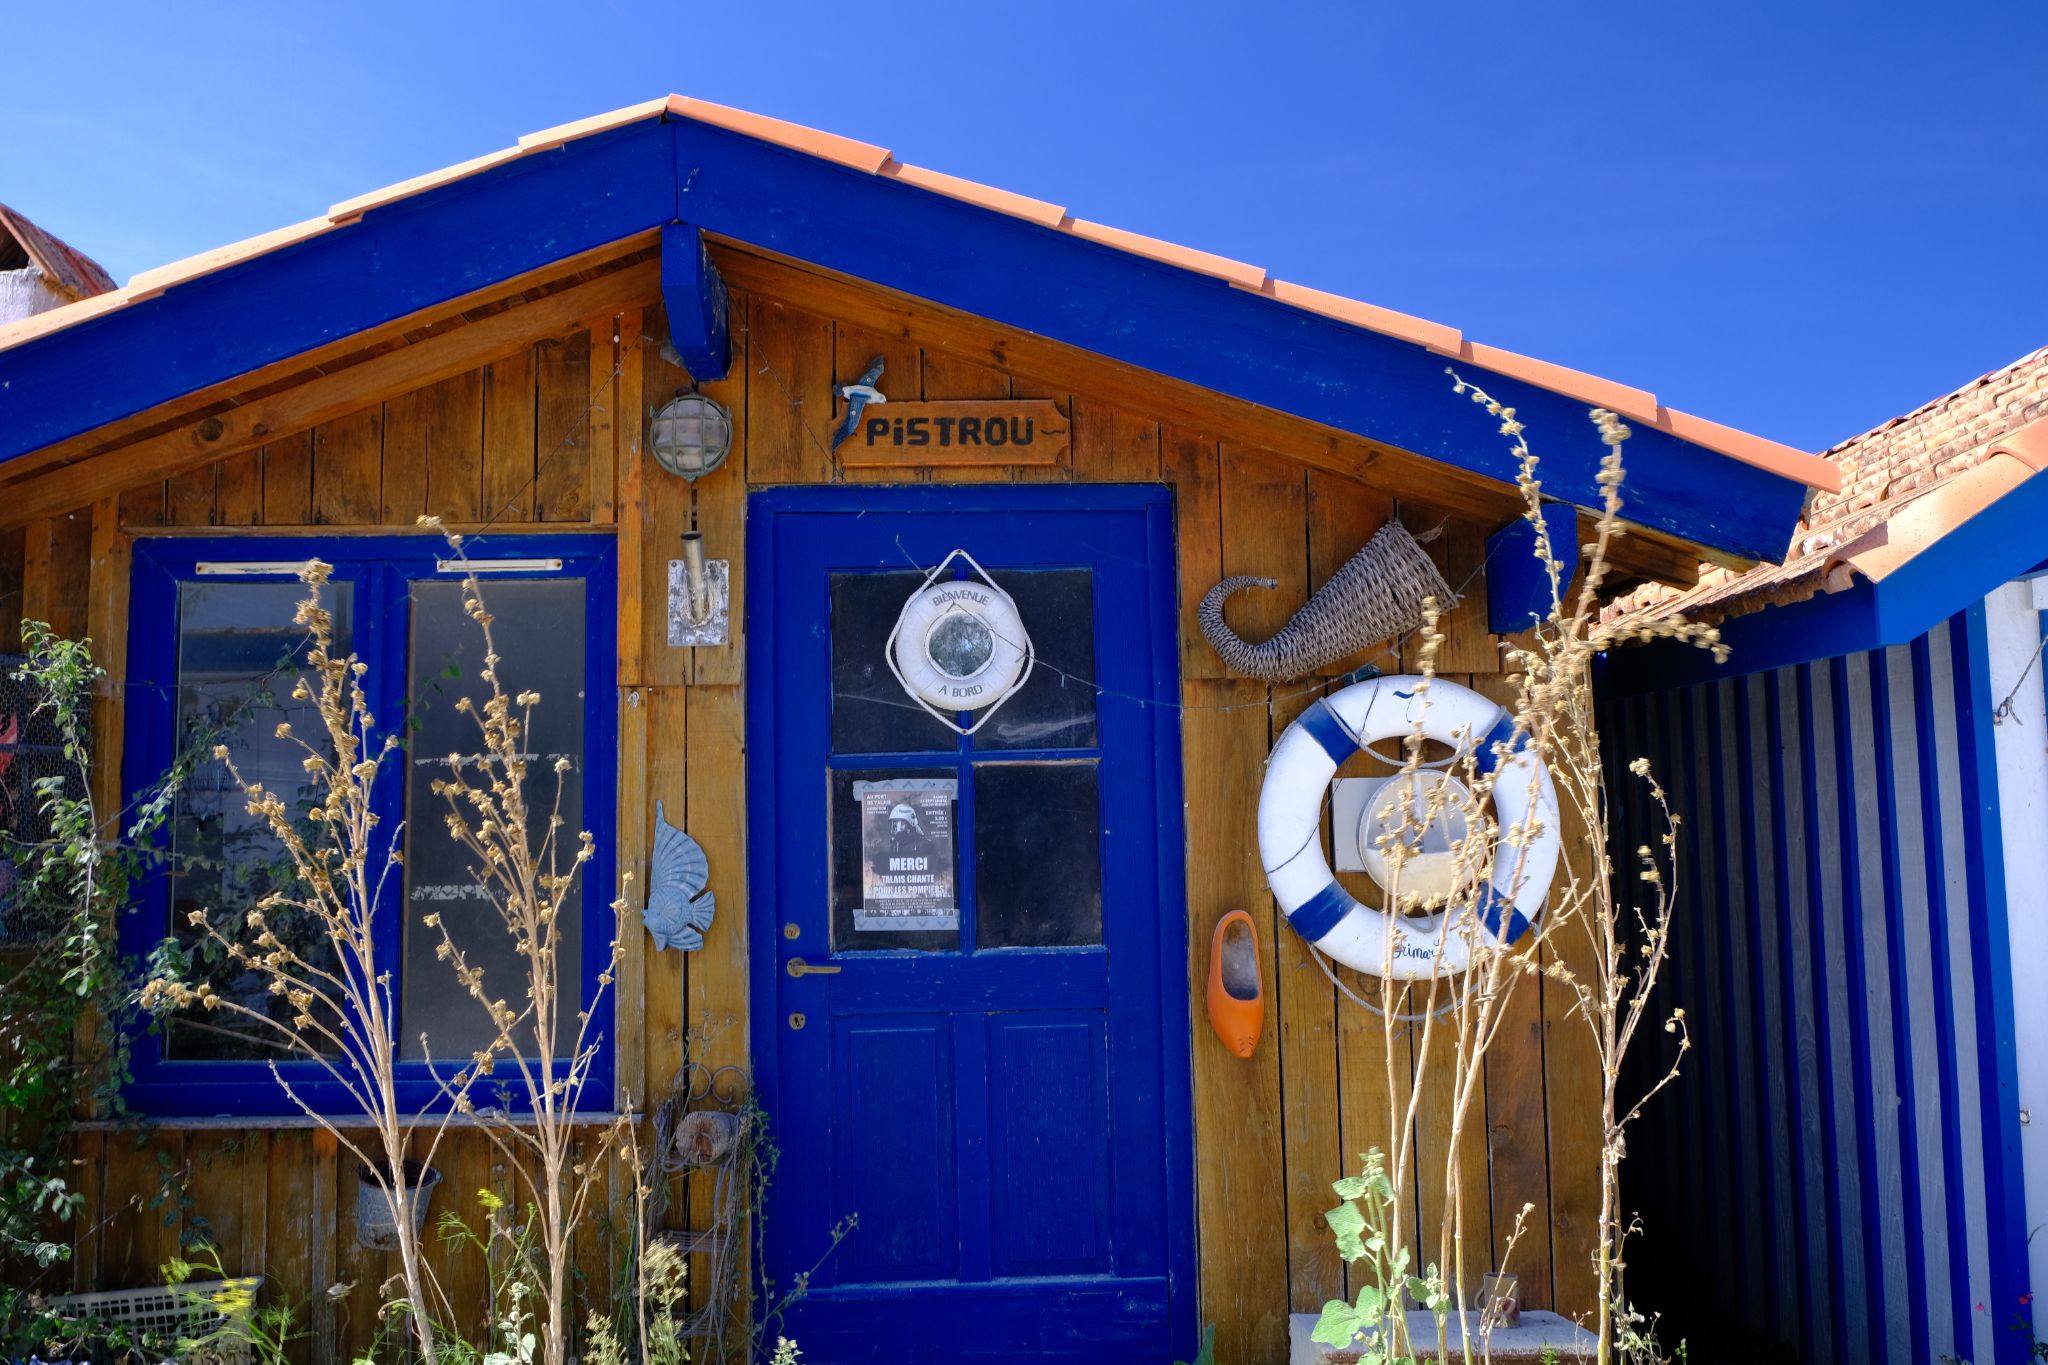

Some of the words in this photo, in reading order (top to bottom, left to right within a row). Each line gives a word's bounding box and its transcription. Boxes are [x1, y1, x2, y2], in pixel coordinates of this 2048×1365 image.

[932, 590, 990, 607] BIENVENUE
[952, 684, 983, 698] BORD
[889, 857, 928, 871] MERCI
[881, 874, 905, 884] TALAIS
[906, 874, 935, 883] CHANTE
[874, 886, 893, 895] POUR
[894, 886, 907, 895] LES
